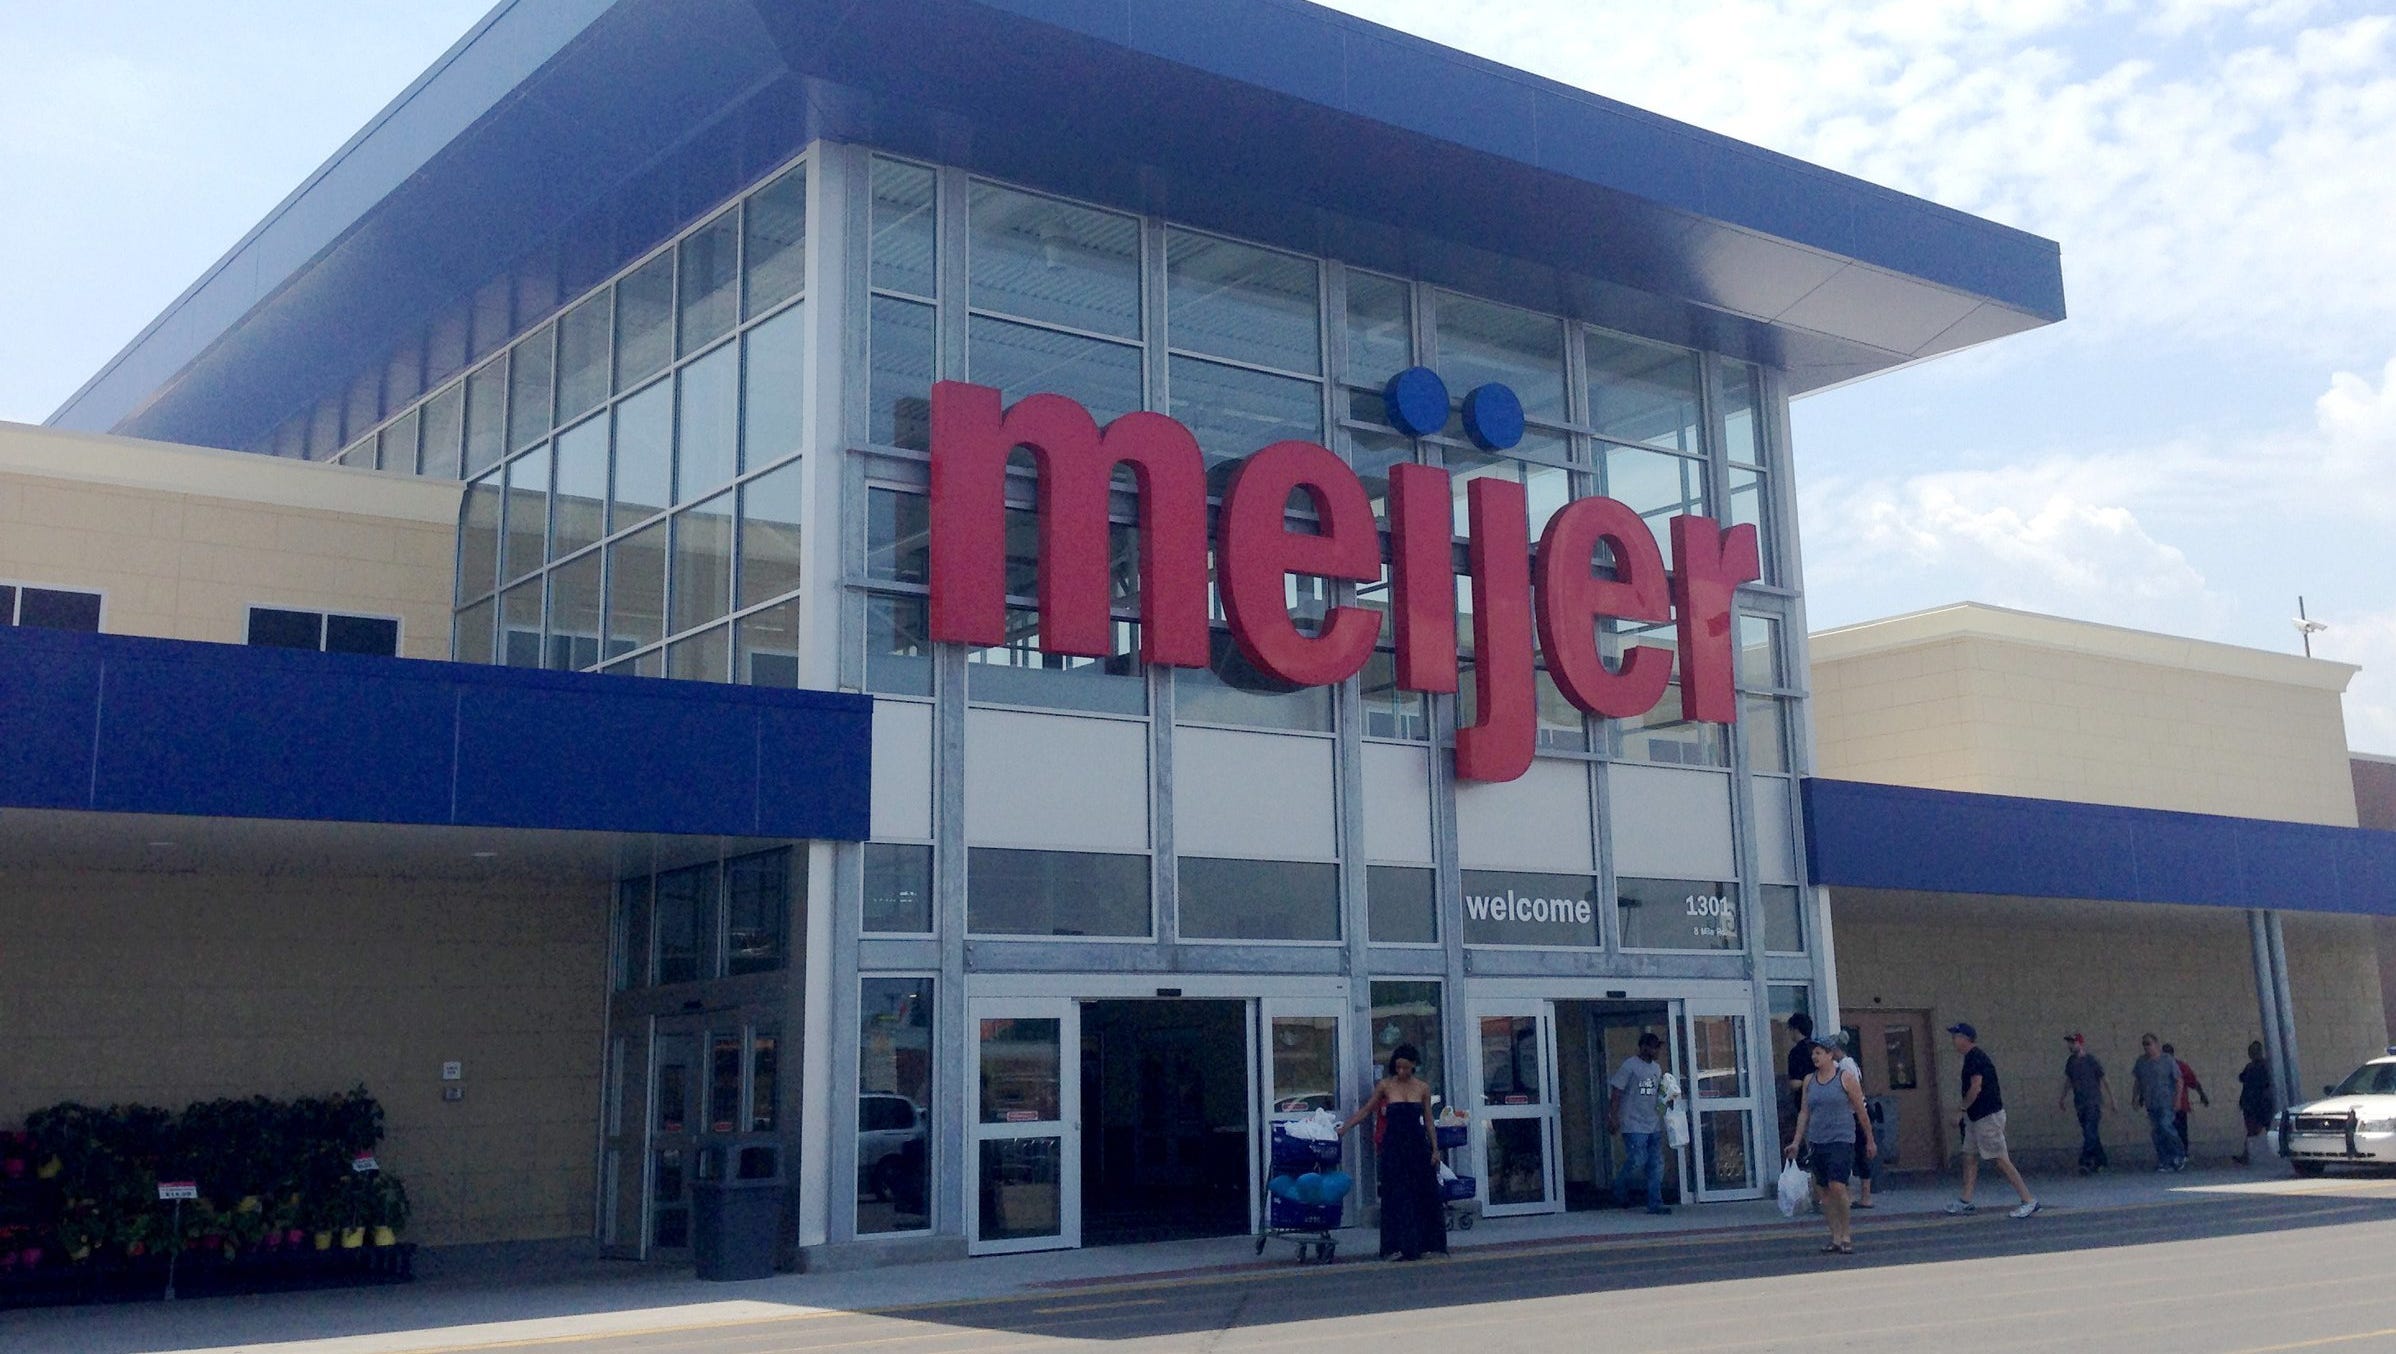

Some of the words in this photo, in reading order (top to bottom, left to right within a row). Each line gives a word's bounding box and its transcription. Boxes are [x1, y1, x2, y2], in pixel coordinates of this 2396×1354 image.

[930, 366, 1761, 783] meijer
[1465, 889, 1591, 924] welcome
[1685, 895, 1731, 917] 1301
